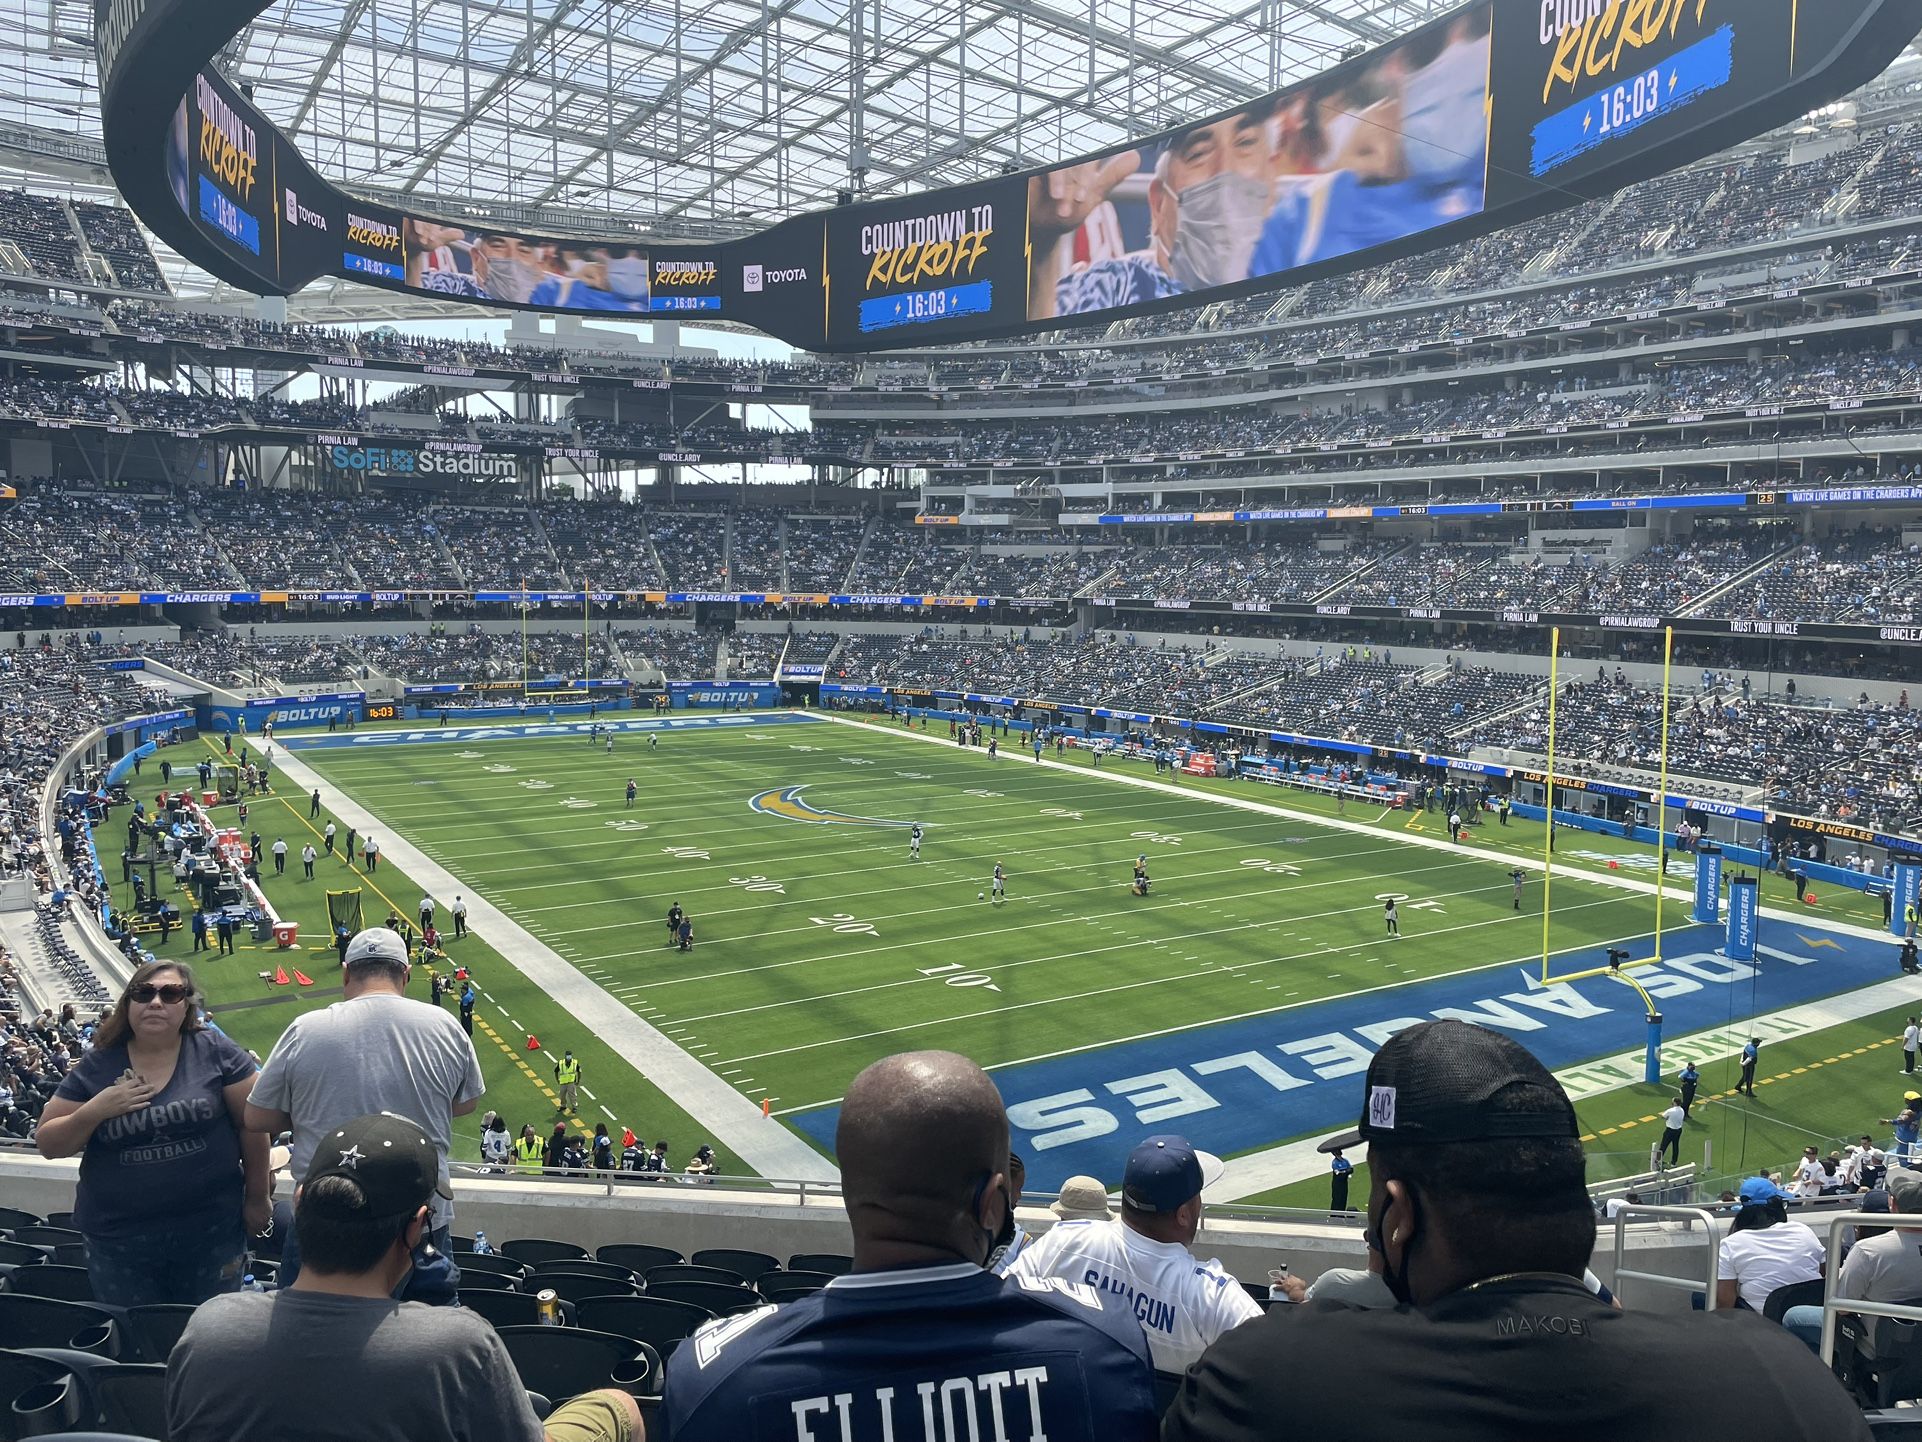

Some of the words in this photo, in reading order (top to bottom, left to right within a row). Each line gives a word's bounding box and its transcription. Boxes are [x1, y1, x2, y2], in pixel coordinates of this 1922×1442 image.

[1600, 69, 1659, 133] 16:03
[196, 73, 244, 147] COUNTDOWN
[245, 123, 256, 158] TO
[201, 111, 257, 204] KICKOFF
[218, 194, 237, 236] 16:03
[297, 204, 327, 231] TOYOTA
[347, 213, 387, 236] COUNTDOWN
[388, 225, 398, 237] TO
[862, 209, 965, 255] COUNTDOWN
[972, 204, 992, 236] TO
[347, 225, 400, 252] KICKOFF
[866, 228, 993, 290] KICKOFF
[363, 258, 383, 275] 16:03
[655, 261, 703, 273] COUNTDOWN
[704, 261, 715, 272] TO
[655, 269, 717, 286] KICKOFF
[766, 268, 807, 283] TOYOTA
[674, 297, 697, 309] 16:03
[906, 291, 946, 318] 16:03
[328, 356, 350, 367] PIRNIA
[351, 359, 364, 368] LAW
[423, 366, 476, 377] @PIRNIALAWGROUP
[531, 374, 547, 382] TRUST
[548, 374, 562, 383] YOUR
[563, 375, 580, 384] UNCLE
[632, 379, 671, 390] @UNCLE.ARDY
[731, 384, 748, 393] PIRNIA
[749, 385, 763, 393] LAW
[318, 435, 341, 445] PIRNIA
[342, 436, 359, 446] LAW
[425, 442, 483, 453] @PIRNIALAWGROUP
[545, 448, 563, 457] TRUST
[564, 449, 578, 457] YOUR
[580, 449, 600, 459] UNCLE
[333, 446, 386, 471] SoFi
[418, 450, 516, 477] Stadium
[658, 453, 701, 463] @UNCLE.ARDY
[768, 456, 788, 464] PIRNIA
[789, 456, 803, 464] LAW
[1759, 494, 1773, 503] 25
[1792, 493, 1814, 501] WATCH
[1815, 492, 1829, 500] LIVE
[1830, 491, 1851, 500] GAMES
[1852, 491, 1861, 499] ON
[1863, 490, 1875, 499] THE
[1875, 489, 1909, 498] CHARGERS
[166, 594, 231, 602] CHARGERS
[371, 593, 400, 601] #BOLTUP
[686, 594, 741, 602] CHARGERS
[850, 595, 901, 604] CHARGERS
[1246, 603, 1257, 611] YOUR
[1257, 604, 1271, 612] UNCLE
[1317, 606, 1350, 615] @UNCLE.ARDY
[1409, 608, 1428, 618] PIRNIA
[1429, 609, 1441, 618] LAW
[1503, 613, 1524, 622] PIRNIA
[1525, 614, 1539, 623] LAW
[1600, 616, 1660, 628] @PIRNIALAWGROUP
[1730, 621, 1752, 633] TRUST
[1753, 622, 1772, 633] YOUR
[1774, 623, 1798, 635] UNCLE
[689, 691, 759, 703] #BOLTUP
[369, 707, 394, 718] 16:03
[1034, 702, 1058, 710] ANGELES
[267, 706, 341, 723] #BOLTUP
[352, 717, 770, 743] CHARGERS
[1447, 759, 1485, 772] #BOLTUP
[1523, 772, 1541, 782] LOS
[1542, 775, 1586, 789] ANGELES
[1586, 782, 1639, 798] CHARGERS
[1685, 799, 1737, 815] #BOLTUP
[1790, 818, 1813, 831] LOS
[1815, 823, 1874, 842] ANGELES
[661, 846, 710, 859] 40
[1240, 858, 1303, 877] 20
[728, 875, 783, 892] 30
[1706, 857, 1716, 911] CHARGERS
[808, 913, 875, 934] 20
[1739, 888, 1750, 946] CHARGERS
[279, 931, 288, 940] G
[916, 962, 992, 988] 10
[1758, 1017, 1812, 1034] IT
[102, 1098, 214, 1141] OWBOYS
[124, 1139, 203, 1163] FOOTBALL
[494, 1139, 502, 1152] 4
